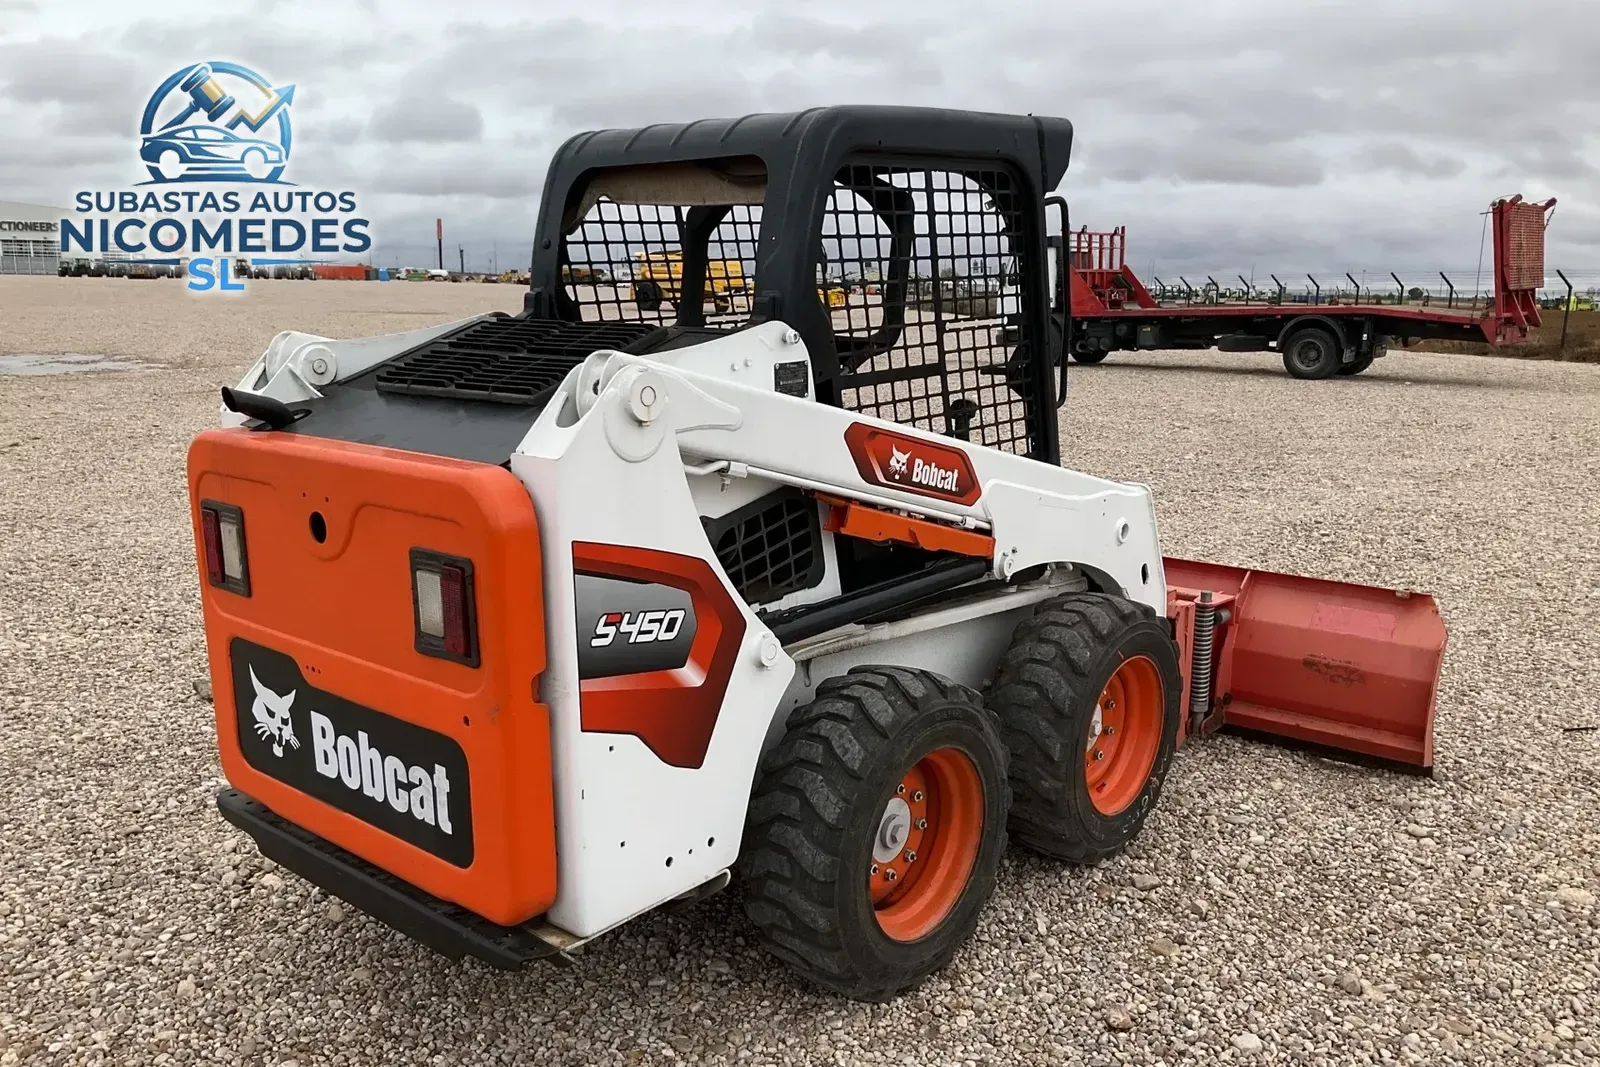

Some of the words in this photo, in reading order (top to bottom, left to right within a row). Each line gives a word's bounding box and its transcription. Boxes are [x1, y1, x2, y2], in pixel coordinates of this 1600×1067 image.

[912, 458, 958, 492] Bobcat
[591, 609, 685, 647] S450
[310, 710, 452, 835] Bobcat
